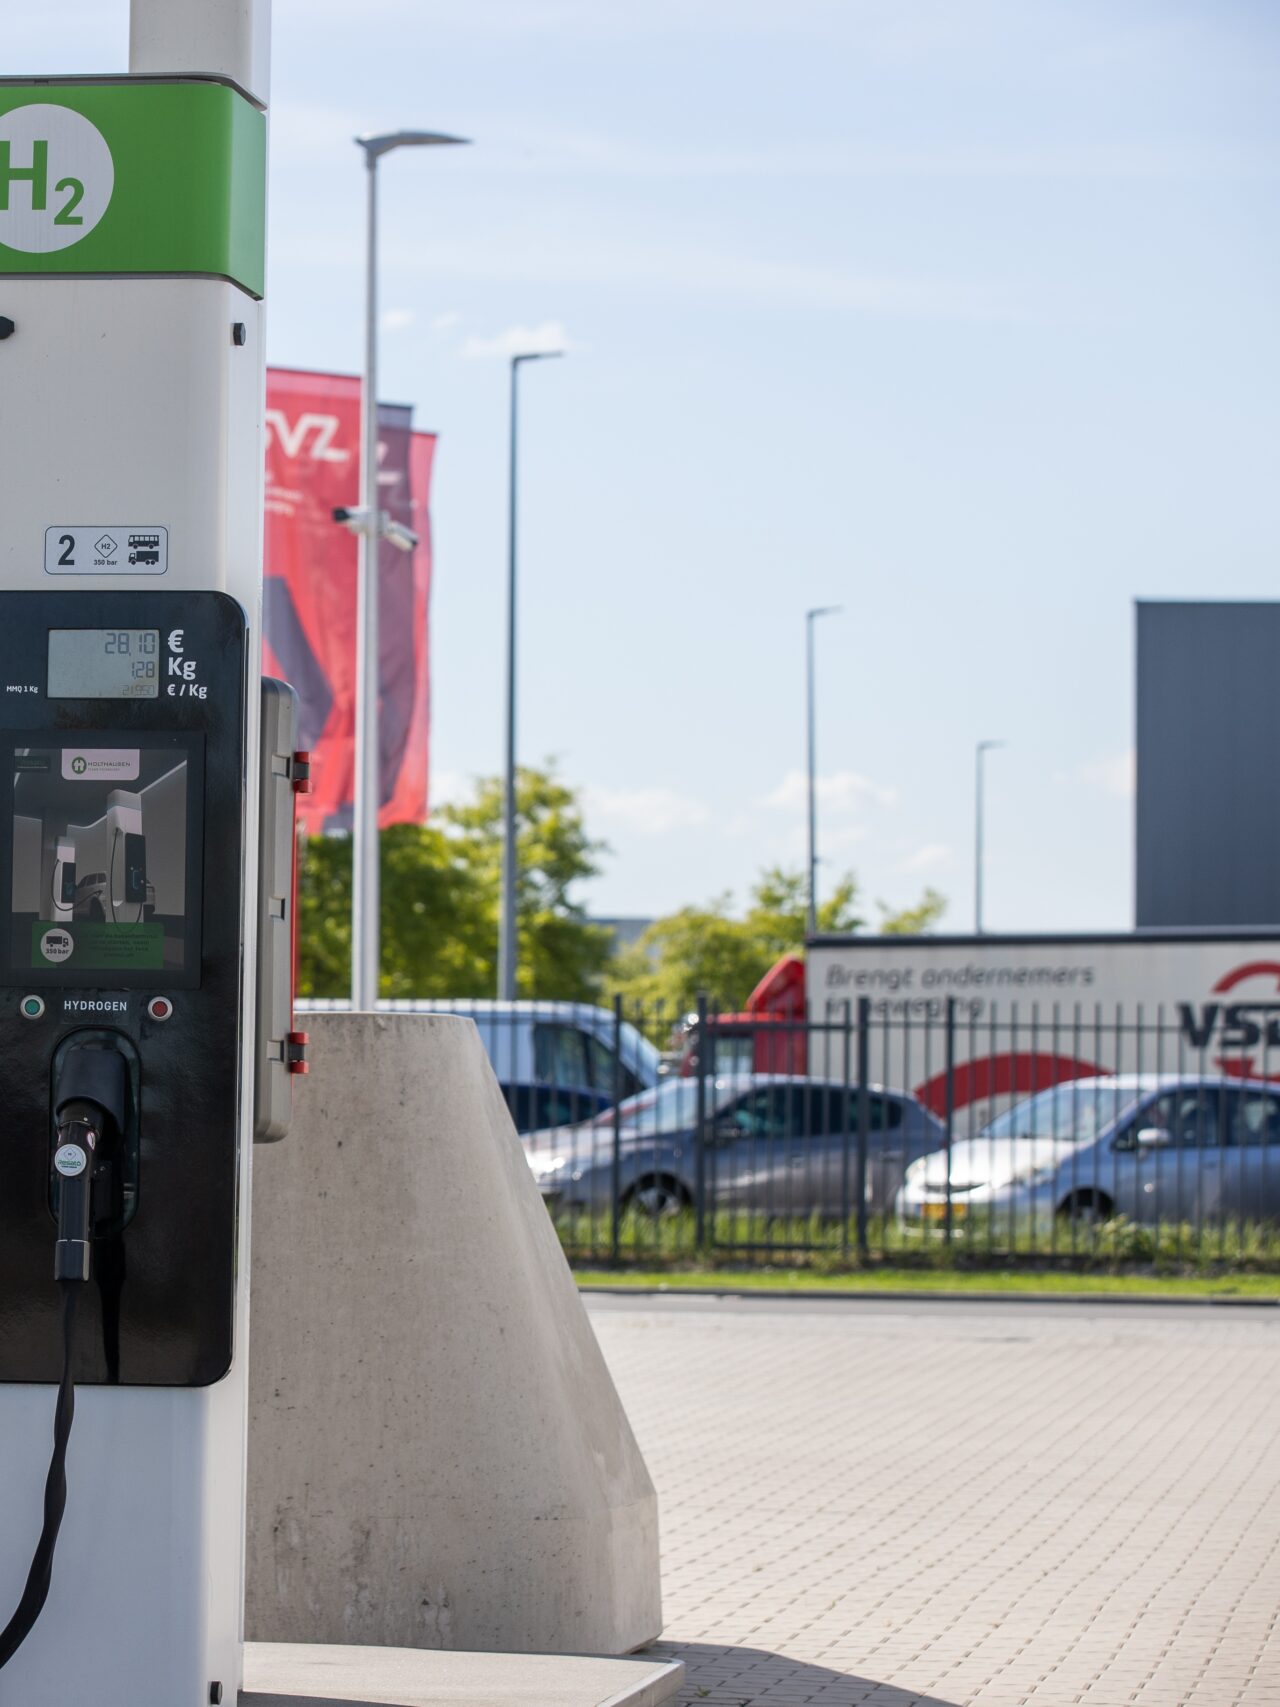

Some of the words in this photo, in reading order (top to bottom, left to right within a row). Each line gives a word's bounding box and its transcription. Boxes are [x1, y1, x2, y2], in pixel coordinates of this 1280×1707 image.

[58, 534, 75, 566] 2
[168, 629, 184, 653] €
[168, 657, 197, 680] Kg
[6, 685, 22, 693] MMQ
[29, 685, 39, 694] Kg
[167, 684, 176, 696] €
[189, 684, 208, 699] Kg
[826, 963, 913, 994] Brengt
[921, 963, 1095, 989] ondernemers
[63, 999, 128, 1012] HYDROGEN
[1177, 1002, 1280, 1048] VS
